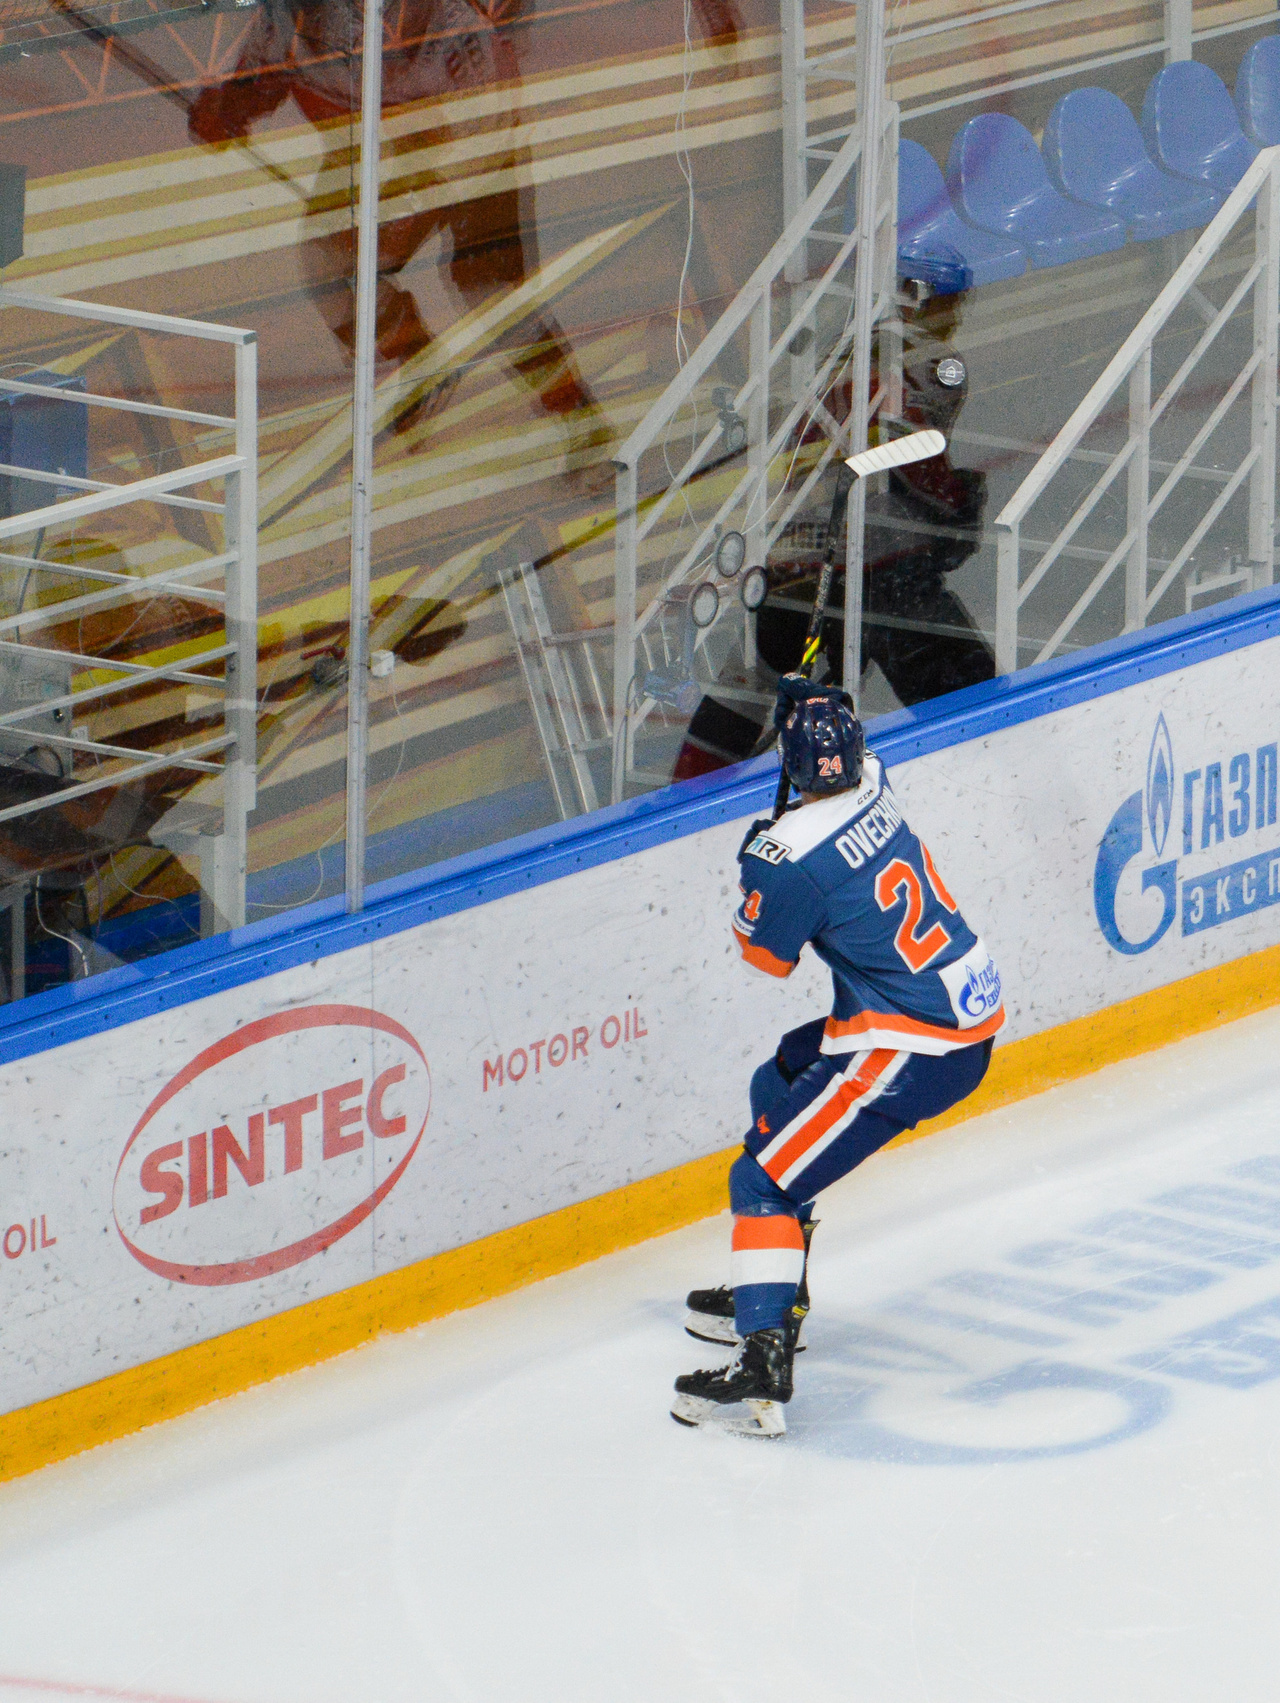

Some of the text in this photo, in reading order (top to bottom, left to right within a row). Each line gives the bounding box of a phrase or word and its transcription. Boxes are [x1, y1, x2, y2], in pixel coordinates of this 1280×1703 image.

[818, 755, 842, 777] 24
[745, 837, 787, 861] ARI
[835, 785, 902, 869] OVECHK
[738, 884, 762, 922] 4
[482, 1006, 648, 1092] MOTOR OIL
[139, 1062, 406, 1226] SINTEC
[2, 1213, 57, 1261] OIL
